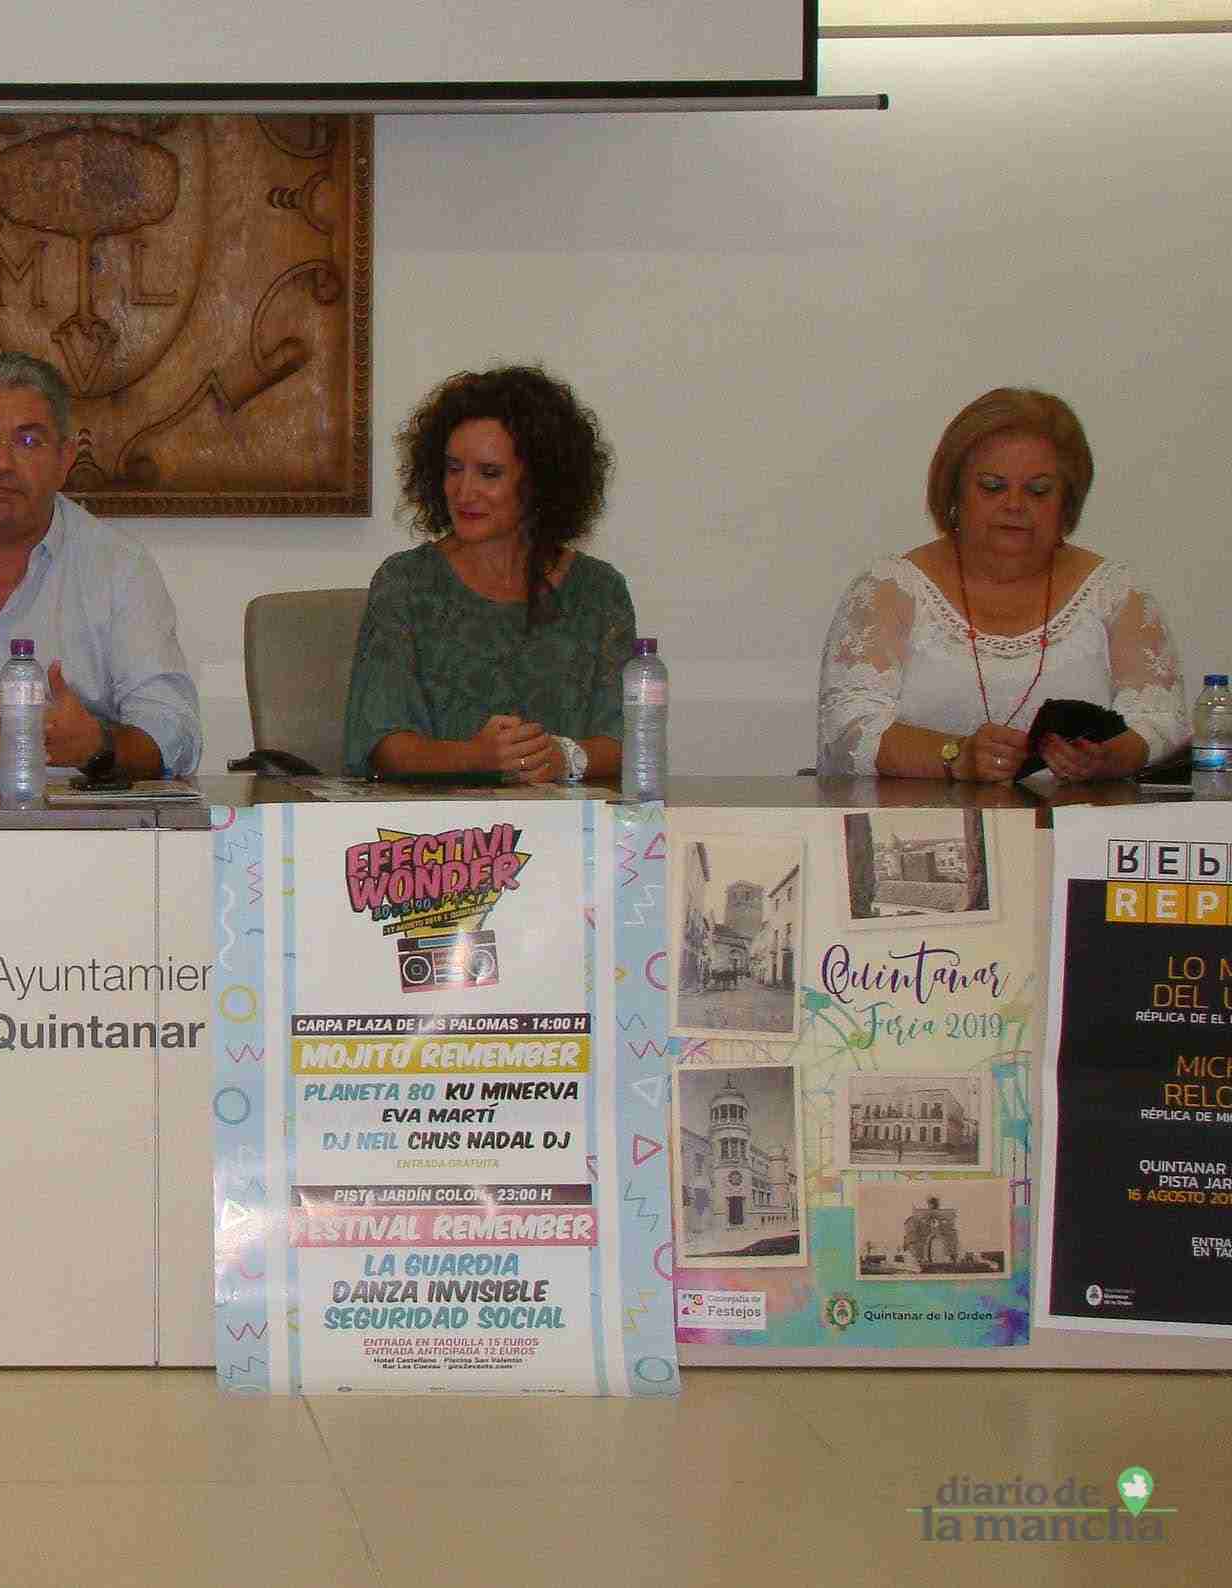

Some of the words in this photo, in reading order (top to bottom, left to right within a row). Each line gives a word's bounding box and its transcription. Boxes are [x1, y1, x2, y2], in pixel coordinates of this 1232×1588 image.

[131, 242, 177, 306] L
[347, 852, 521, 913] WONDER
[1114, 887, 1219, 920] REP
[821, 941, 1010, 1004] Quintanar
[1168, 956, 1206, 981] LO
[1152, 983, 1209, 1009] DEL
[296, 1018, 345, 1032] CARPA
[346, 1018, 395, 1032] PLAZA
[396, 1017, 416, 1032] DE
[449, 1017, 519, 1031] PALOMAS
[531, 1016, 571, 1031] 14:00
[573, 1016, 587, 1031] H
[856, 1000, 936, 1050] Feria
[944, 1012, 1004, 1039] 2019
[1135, 1009, 1186, 1024] RÉPLICA
[1190, 1013, 1207, 1024] DE
[1211, 1014, 1225, 1024] EL
[300, 1041, 412, 1070] MOJITO
[419, 1040, 583, 1069] REMEMBER
[1175, 1056, 1232, 1079] MIC
[303, 1082, 401, 1101] PLANETA
[407, 1082, 436, 1101] 80
[444, 1082, 474, 1101] KU
[479, 1081, 579, 1101] MINERVA
[381, 1108, 422, 1123] EVA
[428, 1102, 500, 1123] MARTÍ
[1140, 1107, 1191, 1121] RÉPLICA
[1196, 1111, 1211, 1122] DE
[322, 1131, 353, 1150] DJ
[408, 1130, 462, 1150] CHUS
[467, 1130, 536, 1150] NADAL
[542, 1130, 573, 1150] DJ
[1139, 1159, 1226, 1175] QUINTANAR
[1159, 1175, 1200, 1189] PISTA
[334, 1188, 373, 1202] PISTA
[381, 1187, 432, 1202] JARDÍN
[496, 1188, 537, 1202] 23:00
[540, 1188, 553, 1202] H
[1146, 1189, 1205, 1204] AGOSTO
[431, 1213, 594, 1242] REMEMBER
[1193, 1246, 1210, 1257] EN
[363, 1253, 395, 1277] LA
[404, 1252, 520, 1277] GUARDIA
[332, 1280, 419, 1304] DANZA
[426, 1279, 550, 1303] INVISIBLE
[323, 1306, 470, 1331] SEGURIDAD
[477, 1305, 567, 1329] SOCIAL
[708, 1306, 761, 1319] Festejos
[863, 1310, 923, 1321] Quintanar
[926, 1311, 941, 1321] de
[944, 1310, 955, 1321] la
[957, 1310, 993, 1321] Orden
[363, 1338, 412, 1347] ENTRADA
[416, 1338, 430, 1347] EN
[432, 1337, 484, 1347] TAQUILLA
[503, 1337, 540, 1347] EUROS
[365, 1347, 414, 1356] ENTRADA
[418, 1347, 481, 1356] ANTICIPADA
[499, 1347, 535, 1356] EUROS
